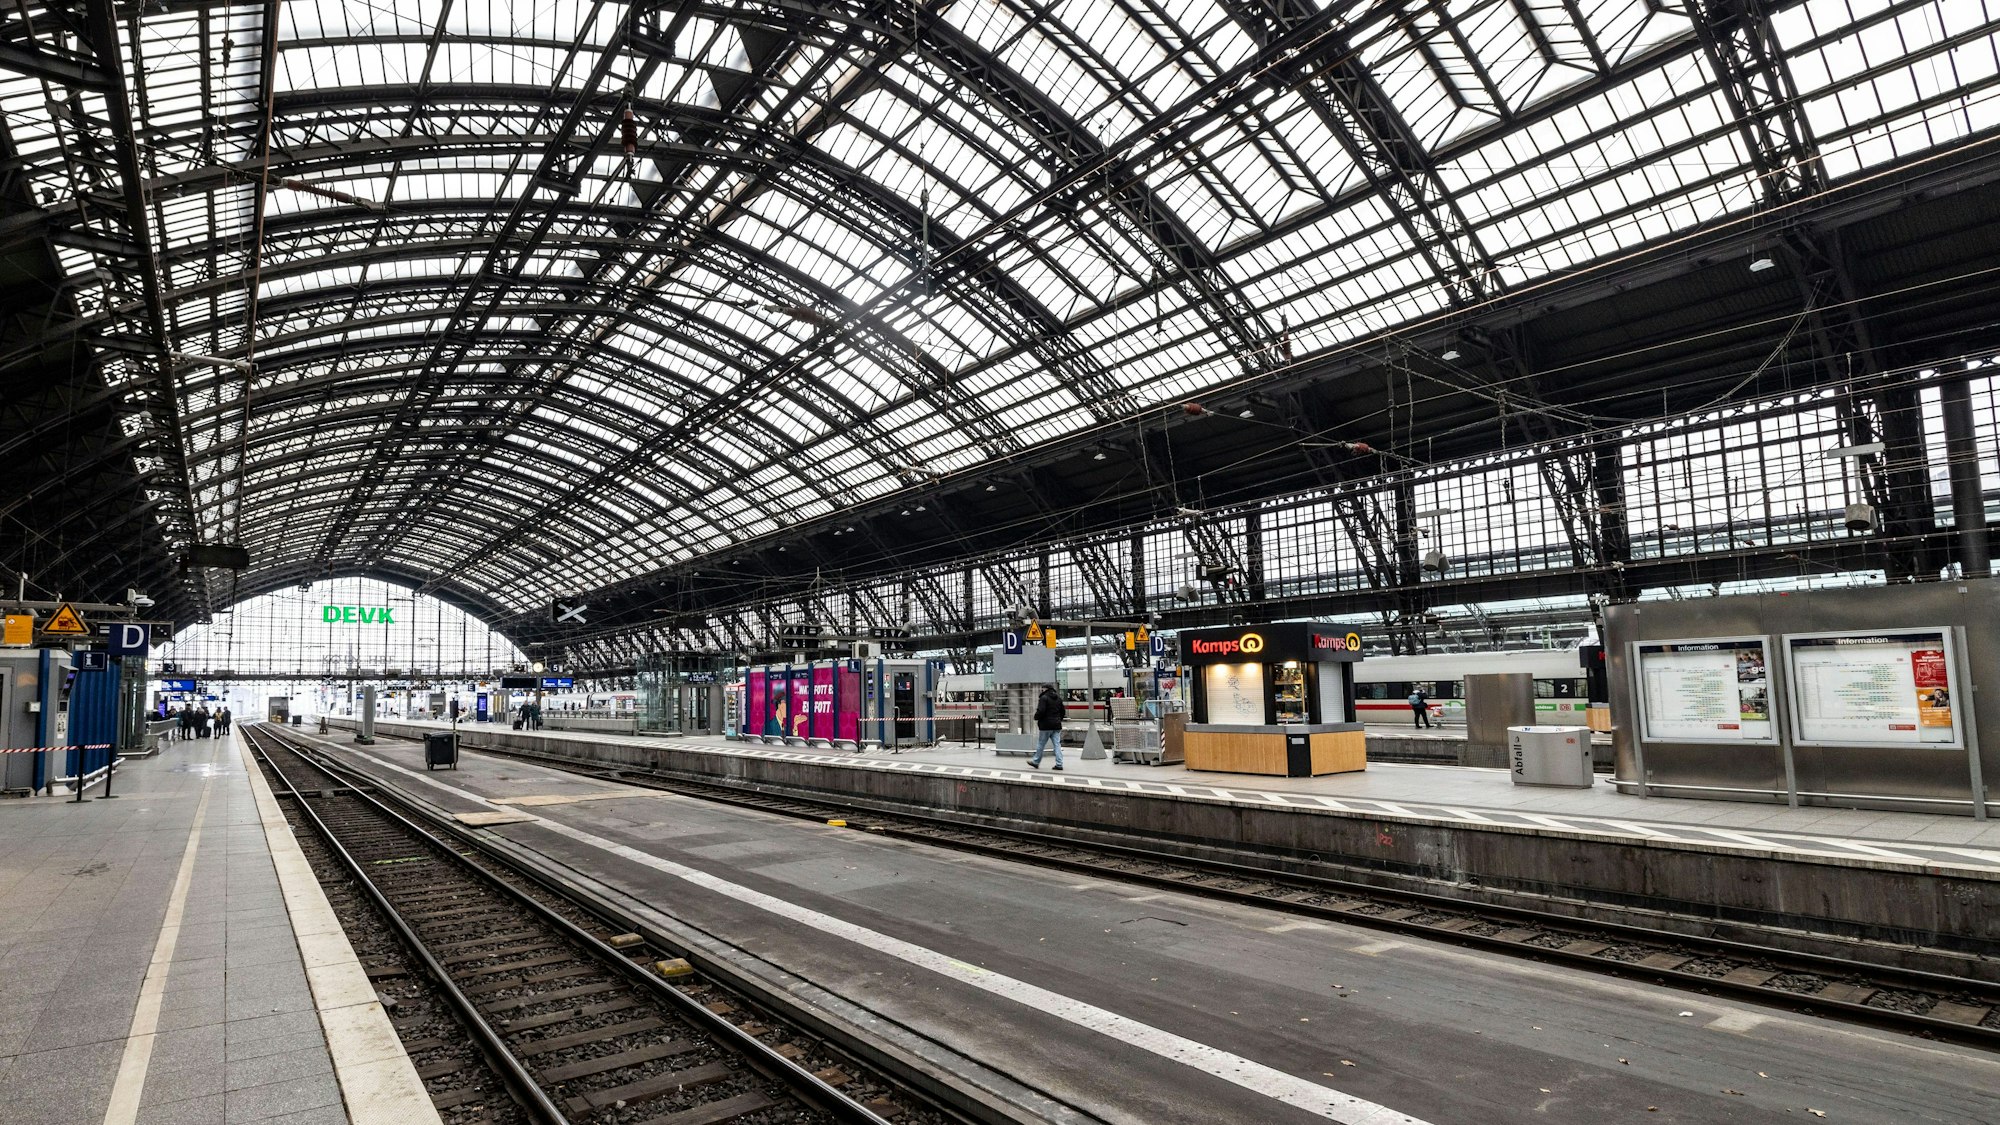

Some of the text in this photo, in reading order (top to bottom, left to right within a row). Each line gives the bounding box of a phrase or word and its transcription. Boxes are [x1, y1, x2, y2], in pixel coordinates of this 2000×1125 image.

[323, 605, 394, 624] DEVK
[121, 624, 145, 649] D
[1007, 632, 1017, 650] D
[1312, 633, 1346, 652] Kamps
[1838, 637, 1889, 645] Information
[1155, 636, 1163, 652] D
[1192, 639, 1240, 655] Kamps
[1677, 644, 1719, 652] Information
[168, 663, 175, 671] 3
[1160, 660, 1165, 669] D
[814, 684, 828, 695] FOTT
[1560, 684, 1568, 693] 2
[814, 701, 831, 713] FOTT
[1513, 743, 1524, 776] Abfall
